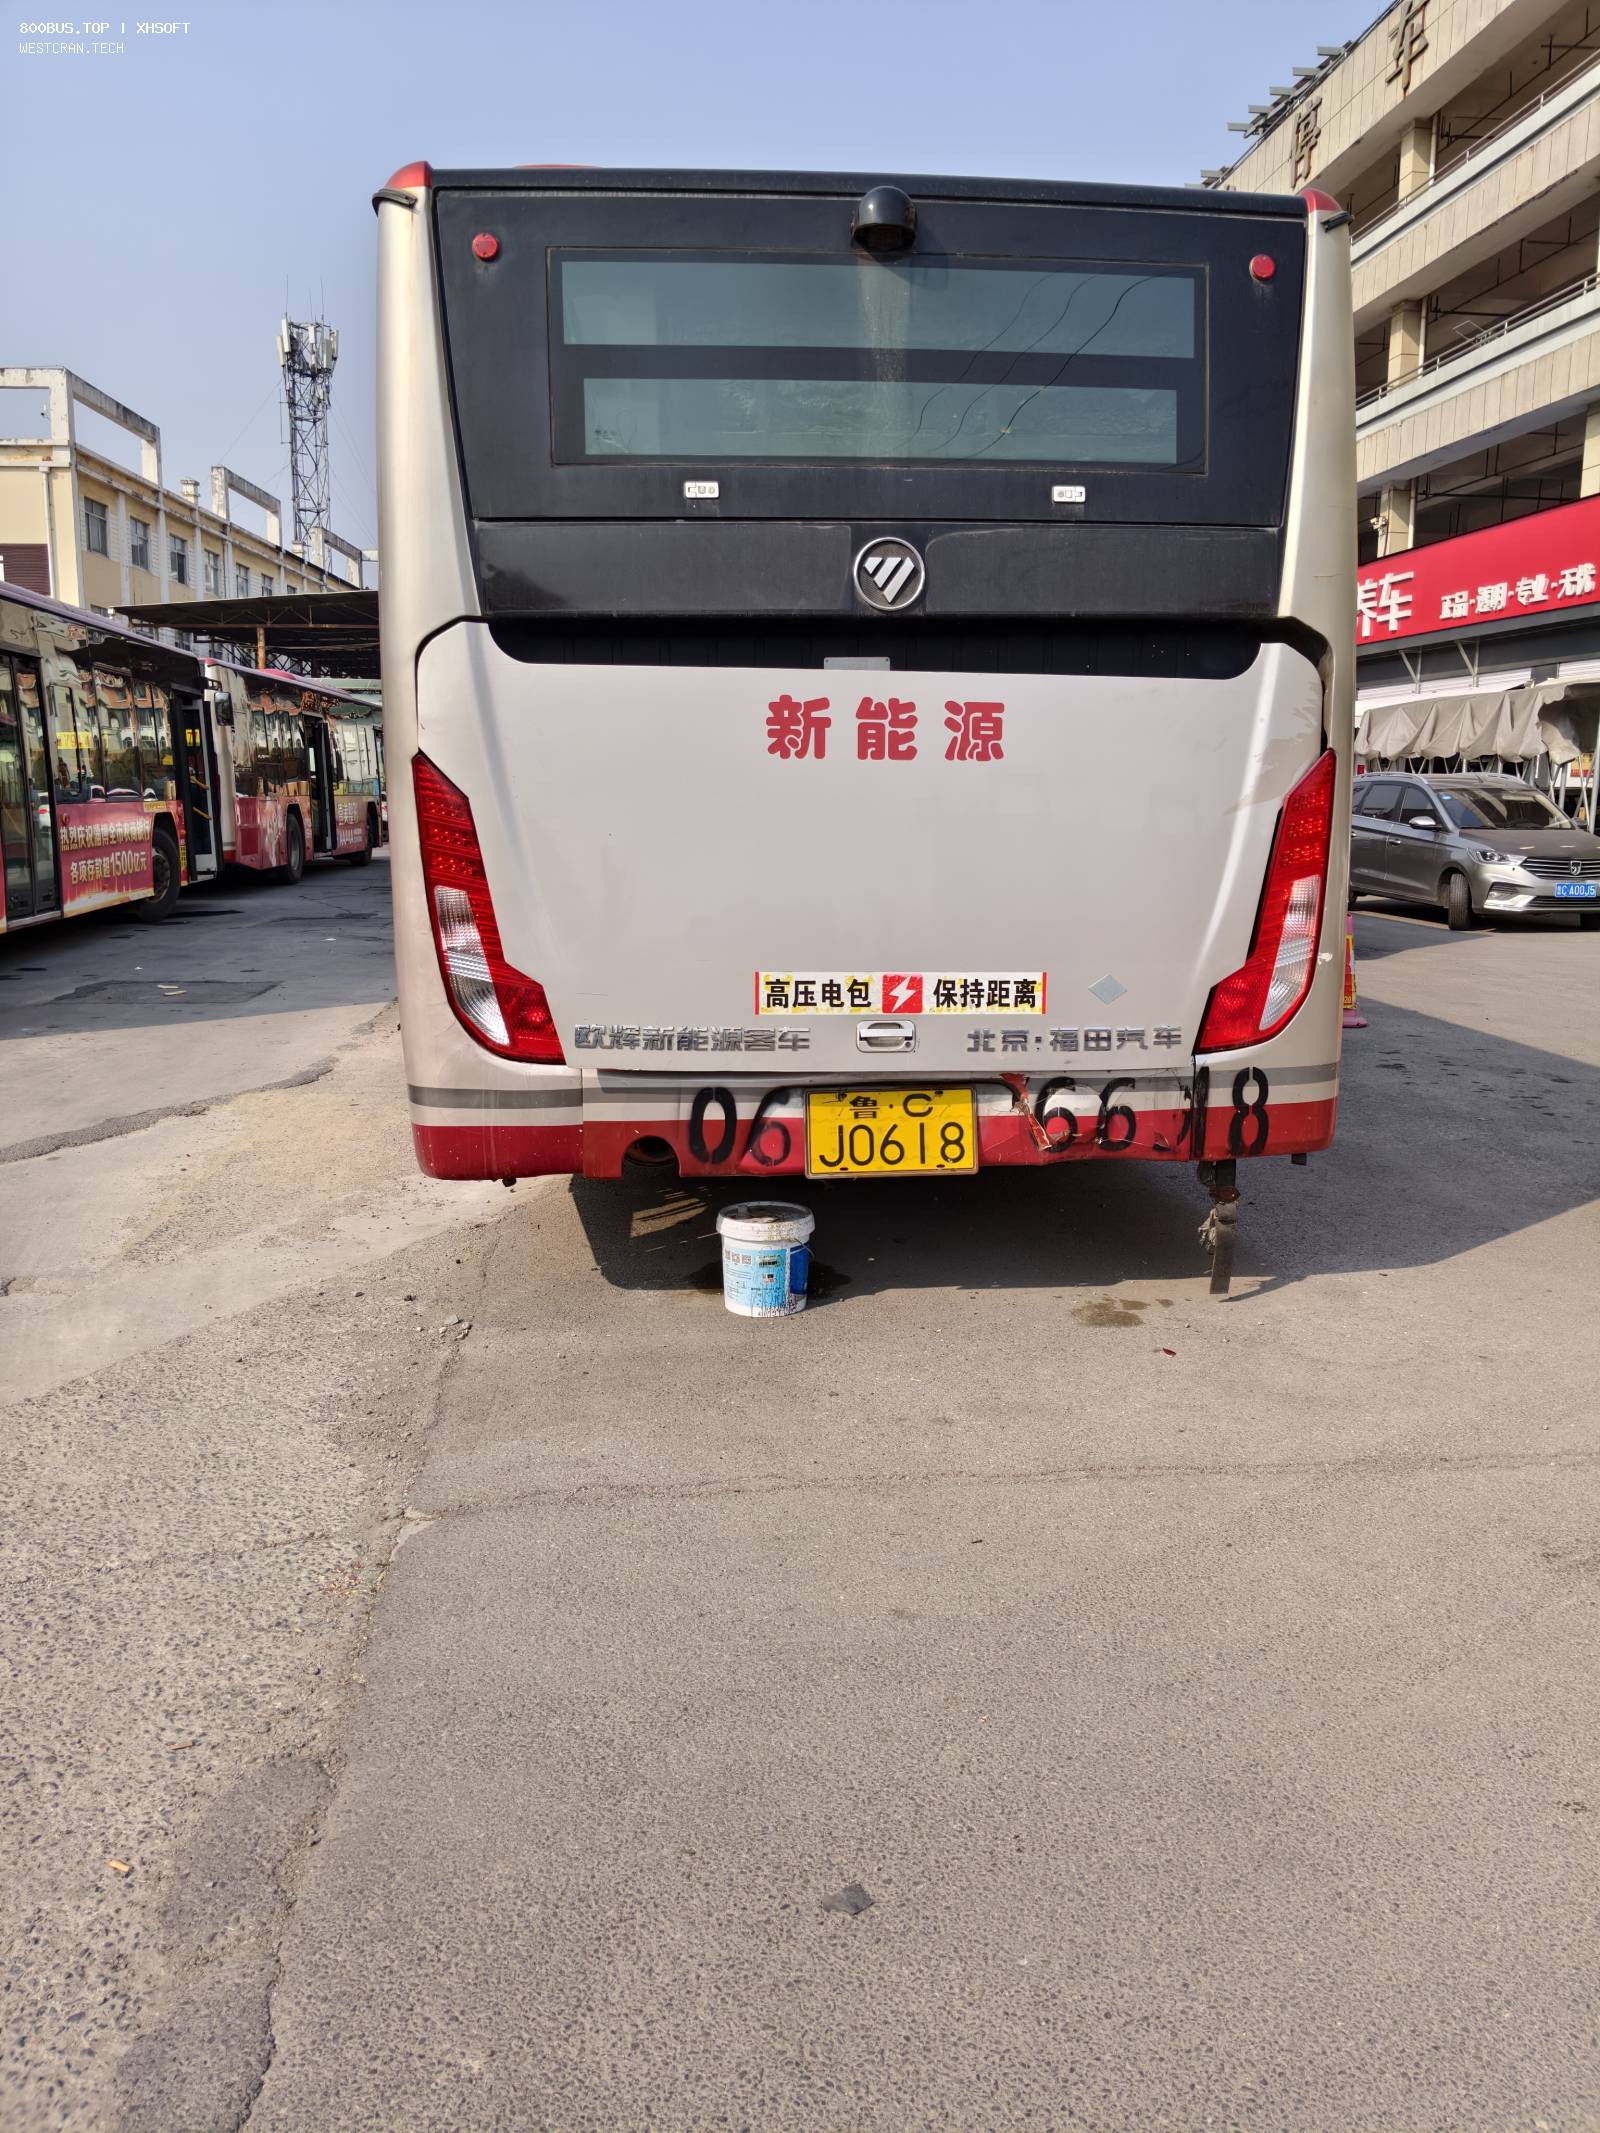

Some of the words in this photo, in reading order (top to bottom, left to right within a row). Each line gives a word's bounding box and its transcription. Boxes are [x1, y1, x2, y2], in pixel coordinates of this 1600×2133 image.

[766, 694, 1005, 762] 新能源
[765, 979, 872, 1009] 高压电包
[933, 978, 1038, 1009] 保持距离
[574, 1023, 811, 1052] 欧辉新能源客车
[818, 1121, 966, 1168] J0618
